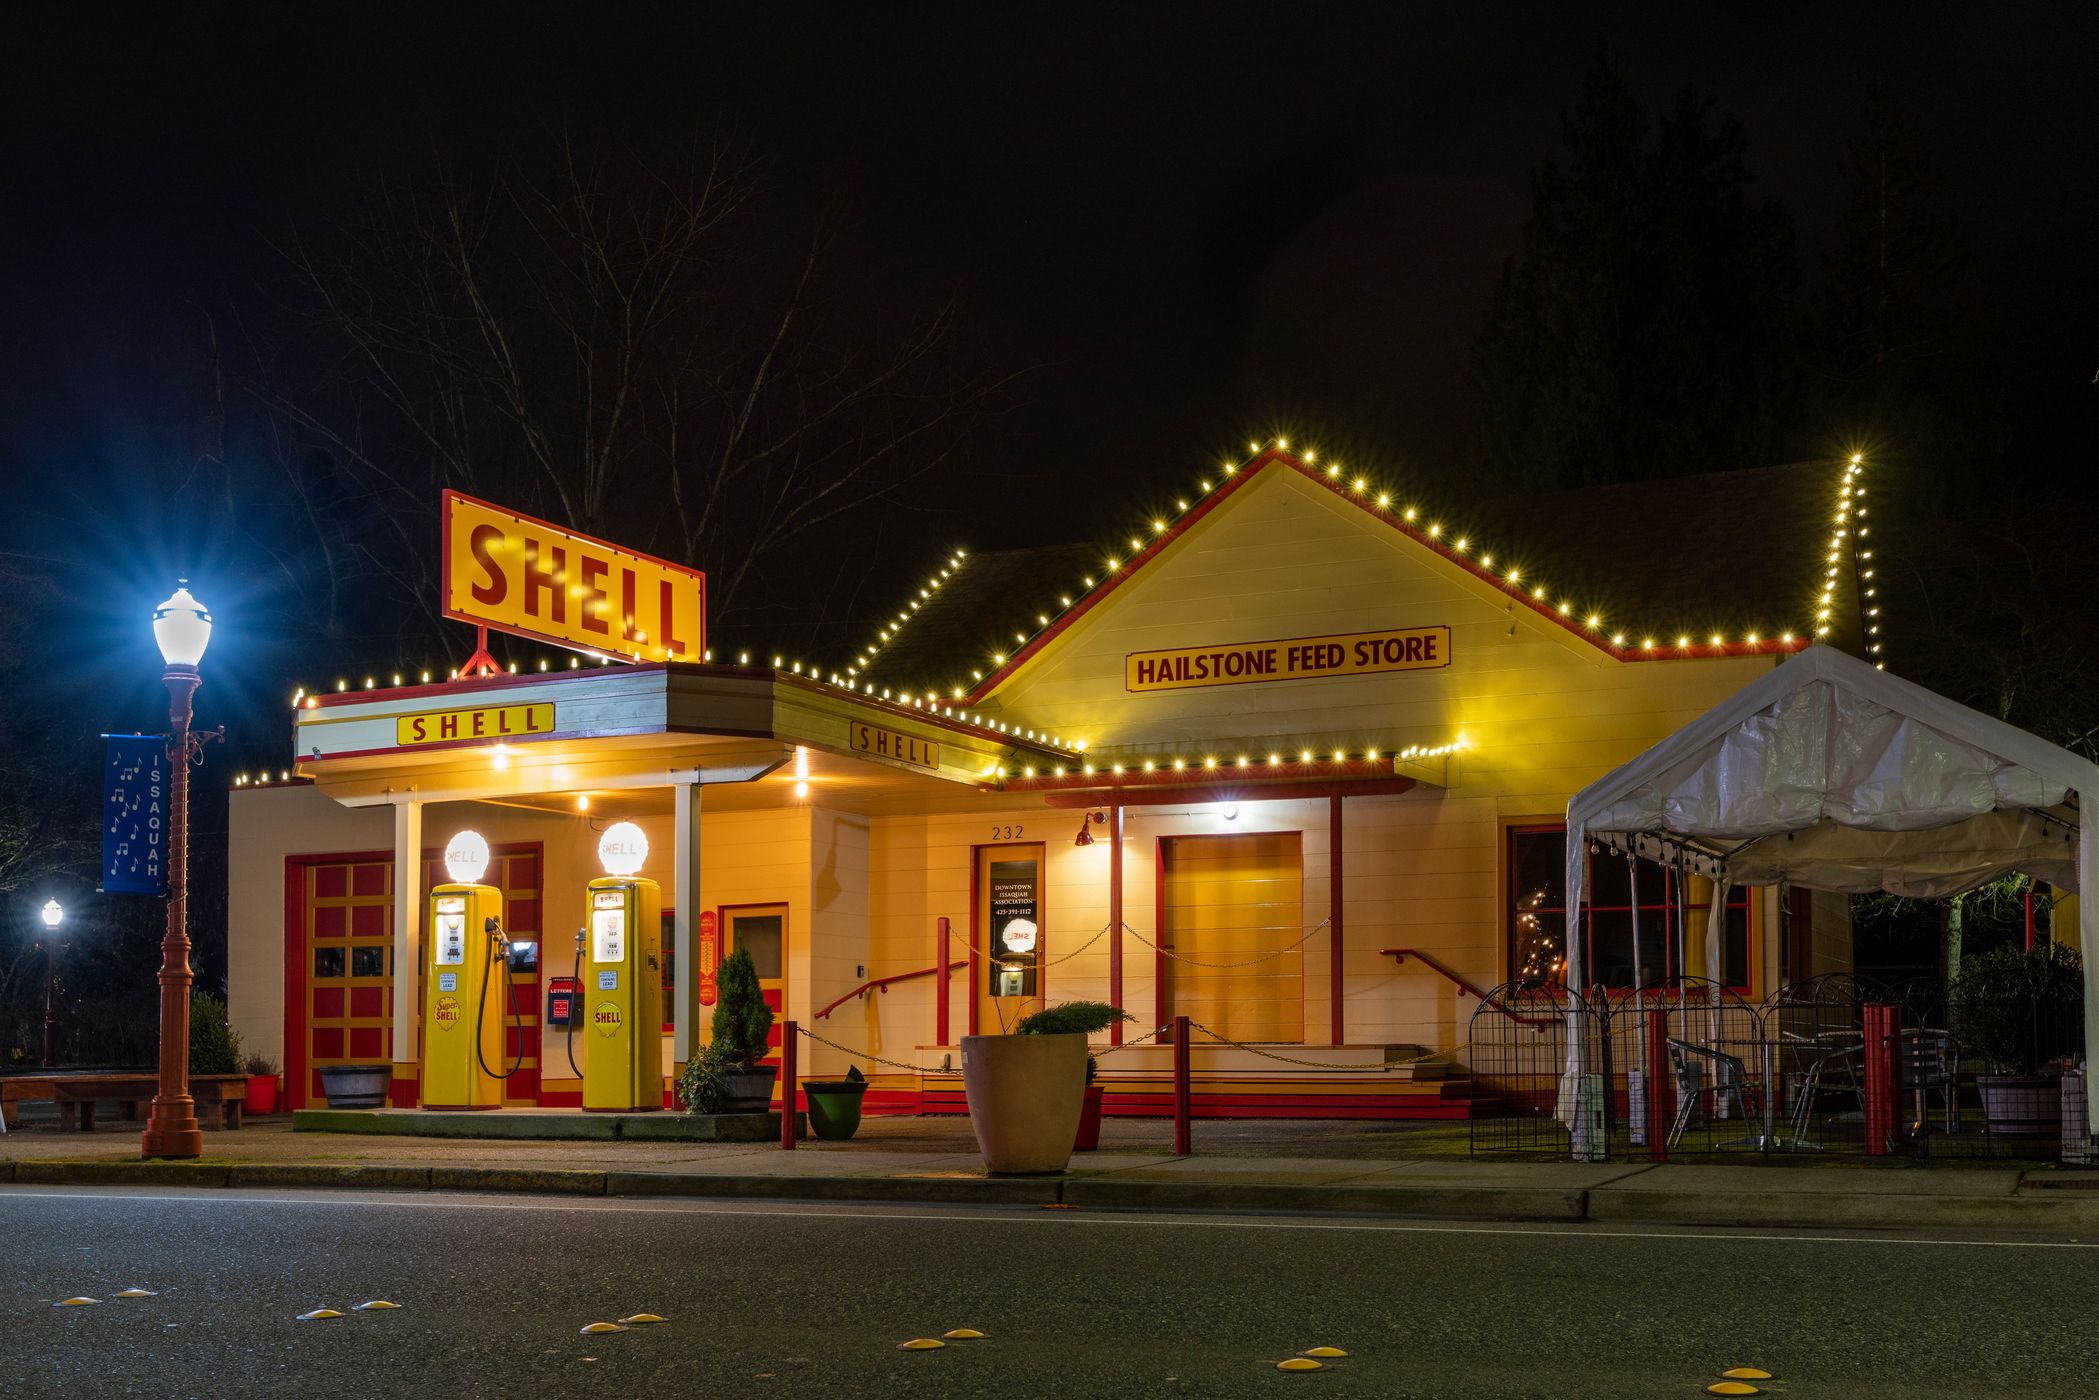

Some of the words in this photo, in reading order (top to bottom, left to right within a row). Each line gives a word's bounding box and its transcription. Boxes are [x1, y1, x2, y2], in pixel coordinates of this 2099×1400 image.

[470, 524, 686, 656] SHELL
[1137, 648, 1277, 685] HAILSTONE
[1287, 643, 1345, 672] FEED
[1354, 635, 1437, 667] STORE
[412, 707, 539, 742] SHELL
[860, 726, 931, 765] SHELL
[147, 754, 161, 877] ISSAQUAH
[992, 825, 1024, 840] 232
[436, 1011, 458, 1021] SHELL
[595, 1012, 621, 1023] SHELL
